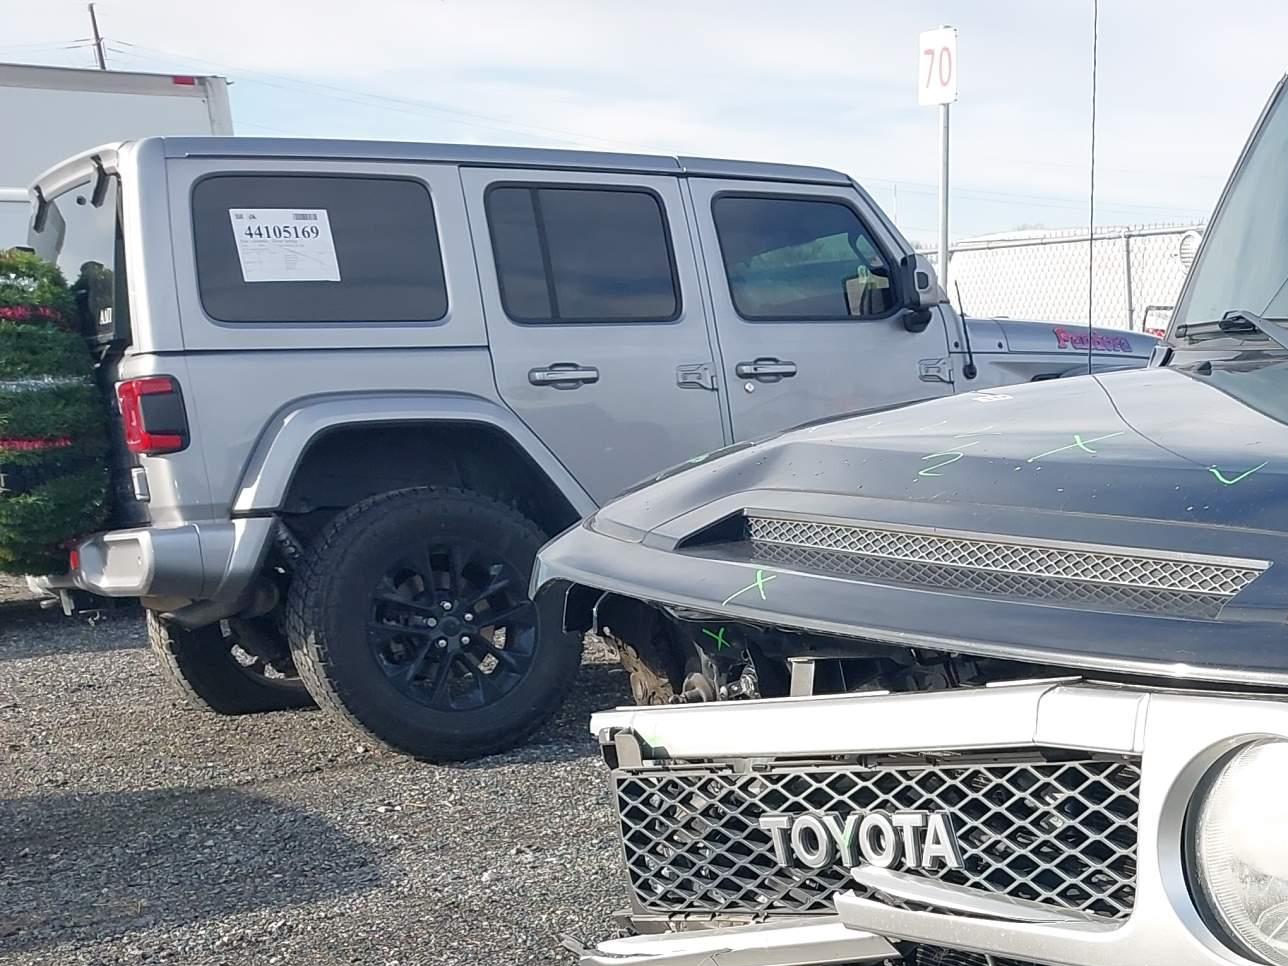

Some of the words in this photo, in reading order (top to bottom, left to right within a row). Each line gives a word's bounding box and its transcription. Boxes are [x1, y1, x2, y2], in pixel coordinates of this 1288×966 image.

[923, 46, 952, 88] 70
[244, 225, 320, 239] 44105169
[758, 802, 965, 870] TOYOTA
